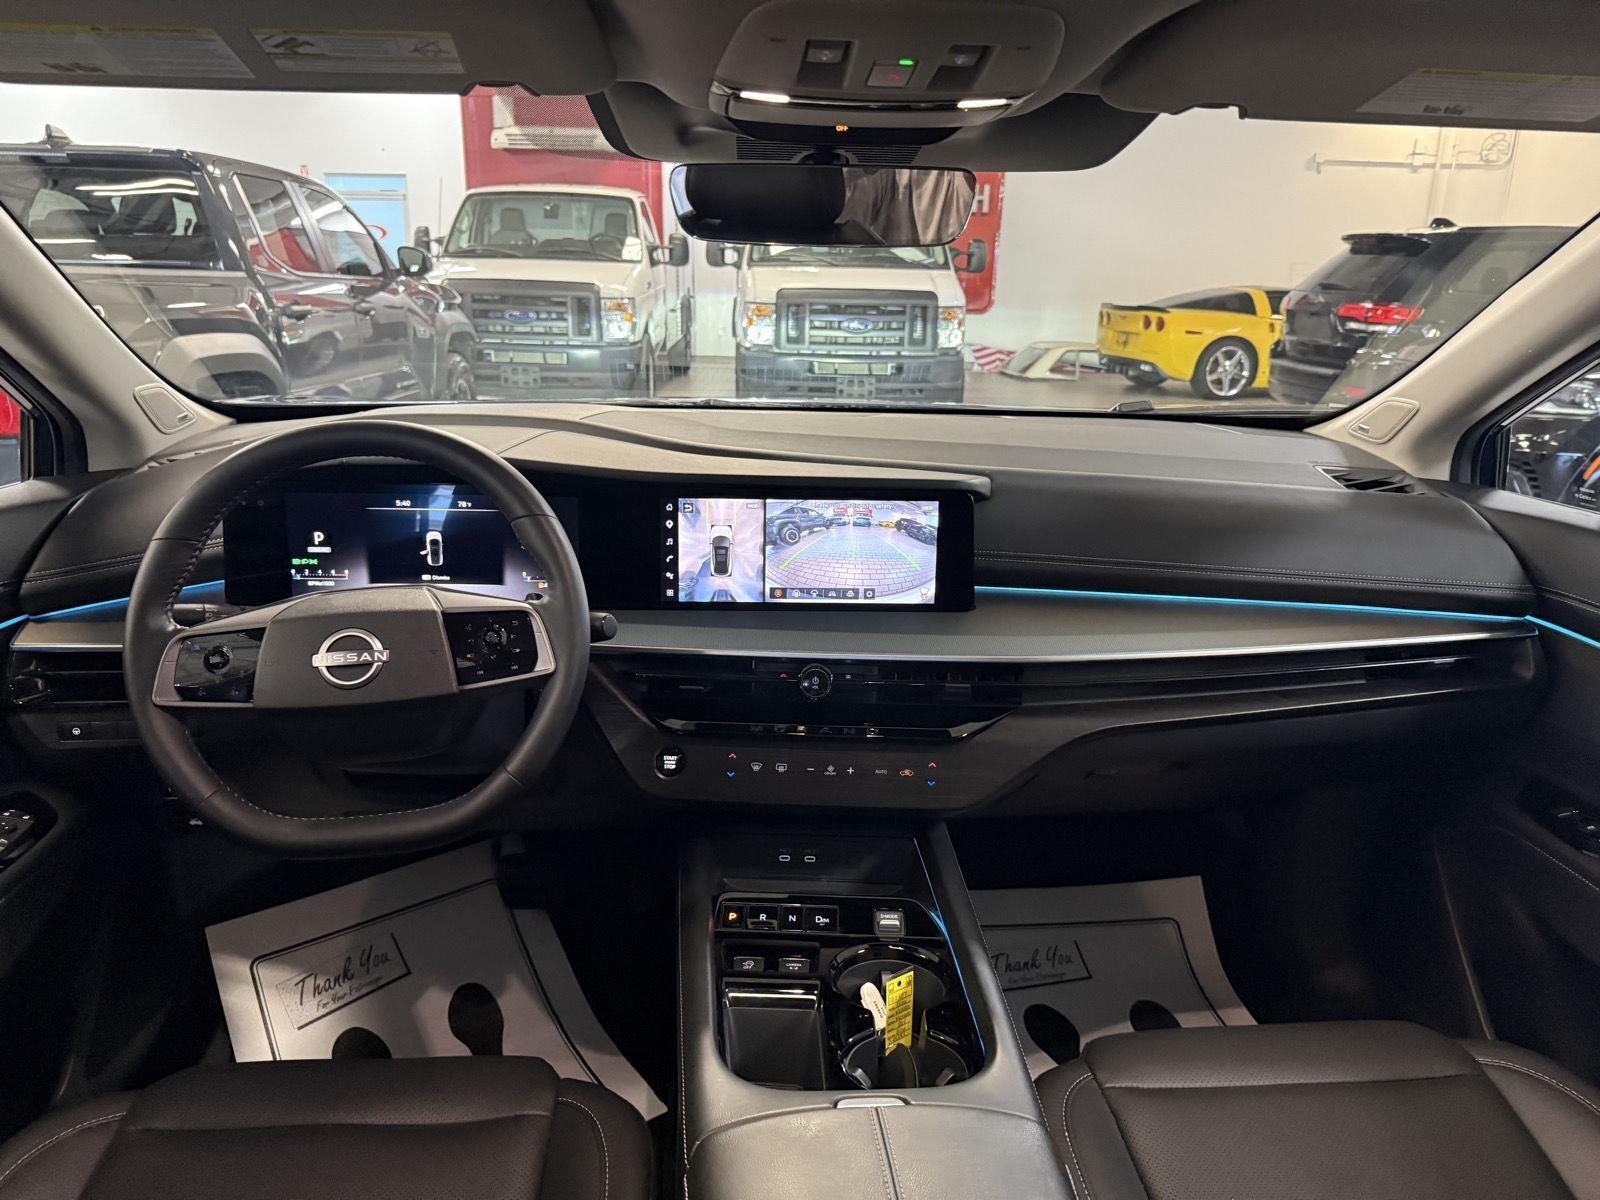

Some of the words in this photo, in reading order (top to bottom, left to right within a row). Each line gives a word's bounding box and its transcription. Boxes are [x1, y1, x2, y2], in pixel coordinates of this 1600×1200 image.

[313, 531, 325, 545] P
[314, 652, 388, 667] NISSAN
[729, 912, 737, 921] P
[759, 913, 767, 921] R
[789, 914, 796, 922] N
[991, 948, 1041, 973] Thank
[1046, 945, 1073, 968] You
[294, 957, 354, 1007] Thank
[359, 945, 391, 975] You
